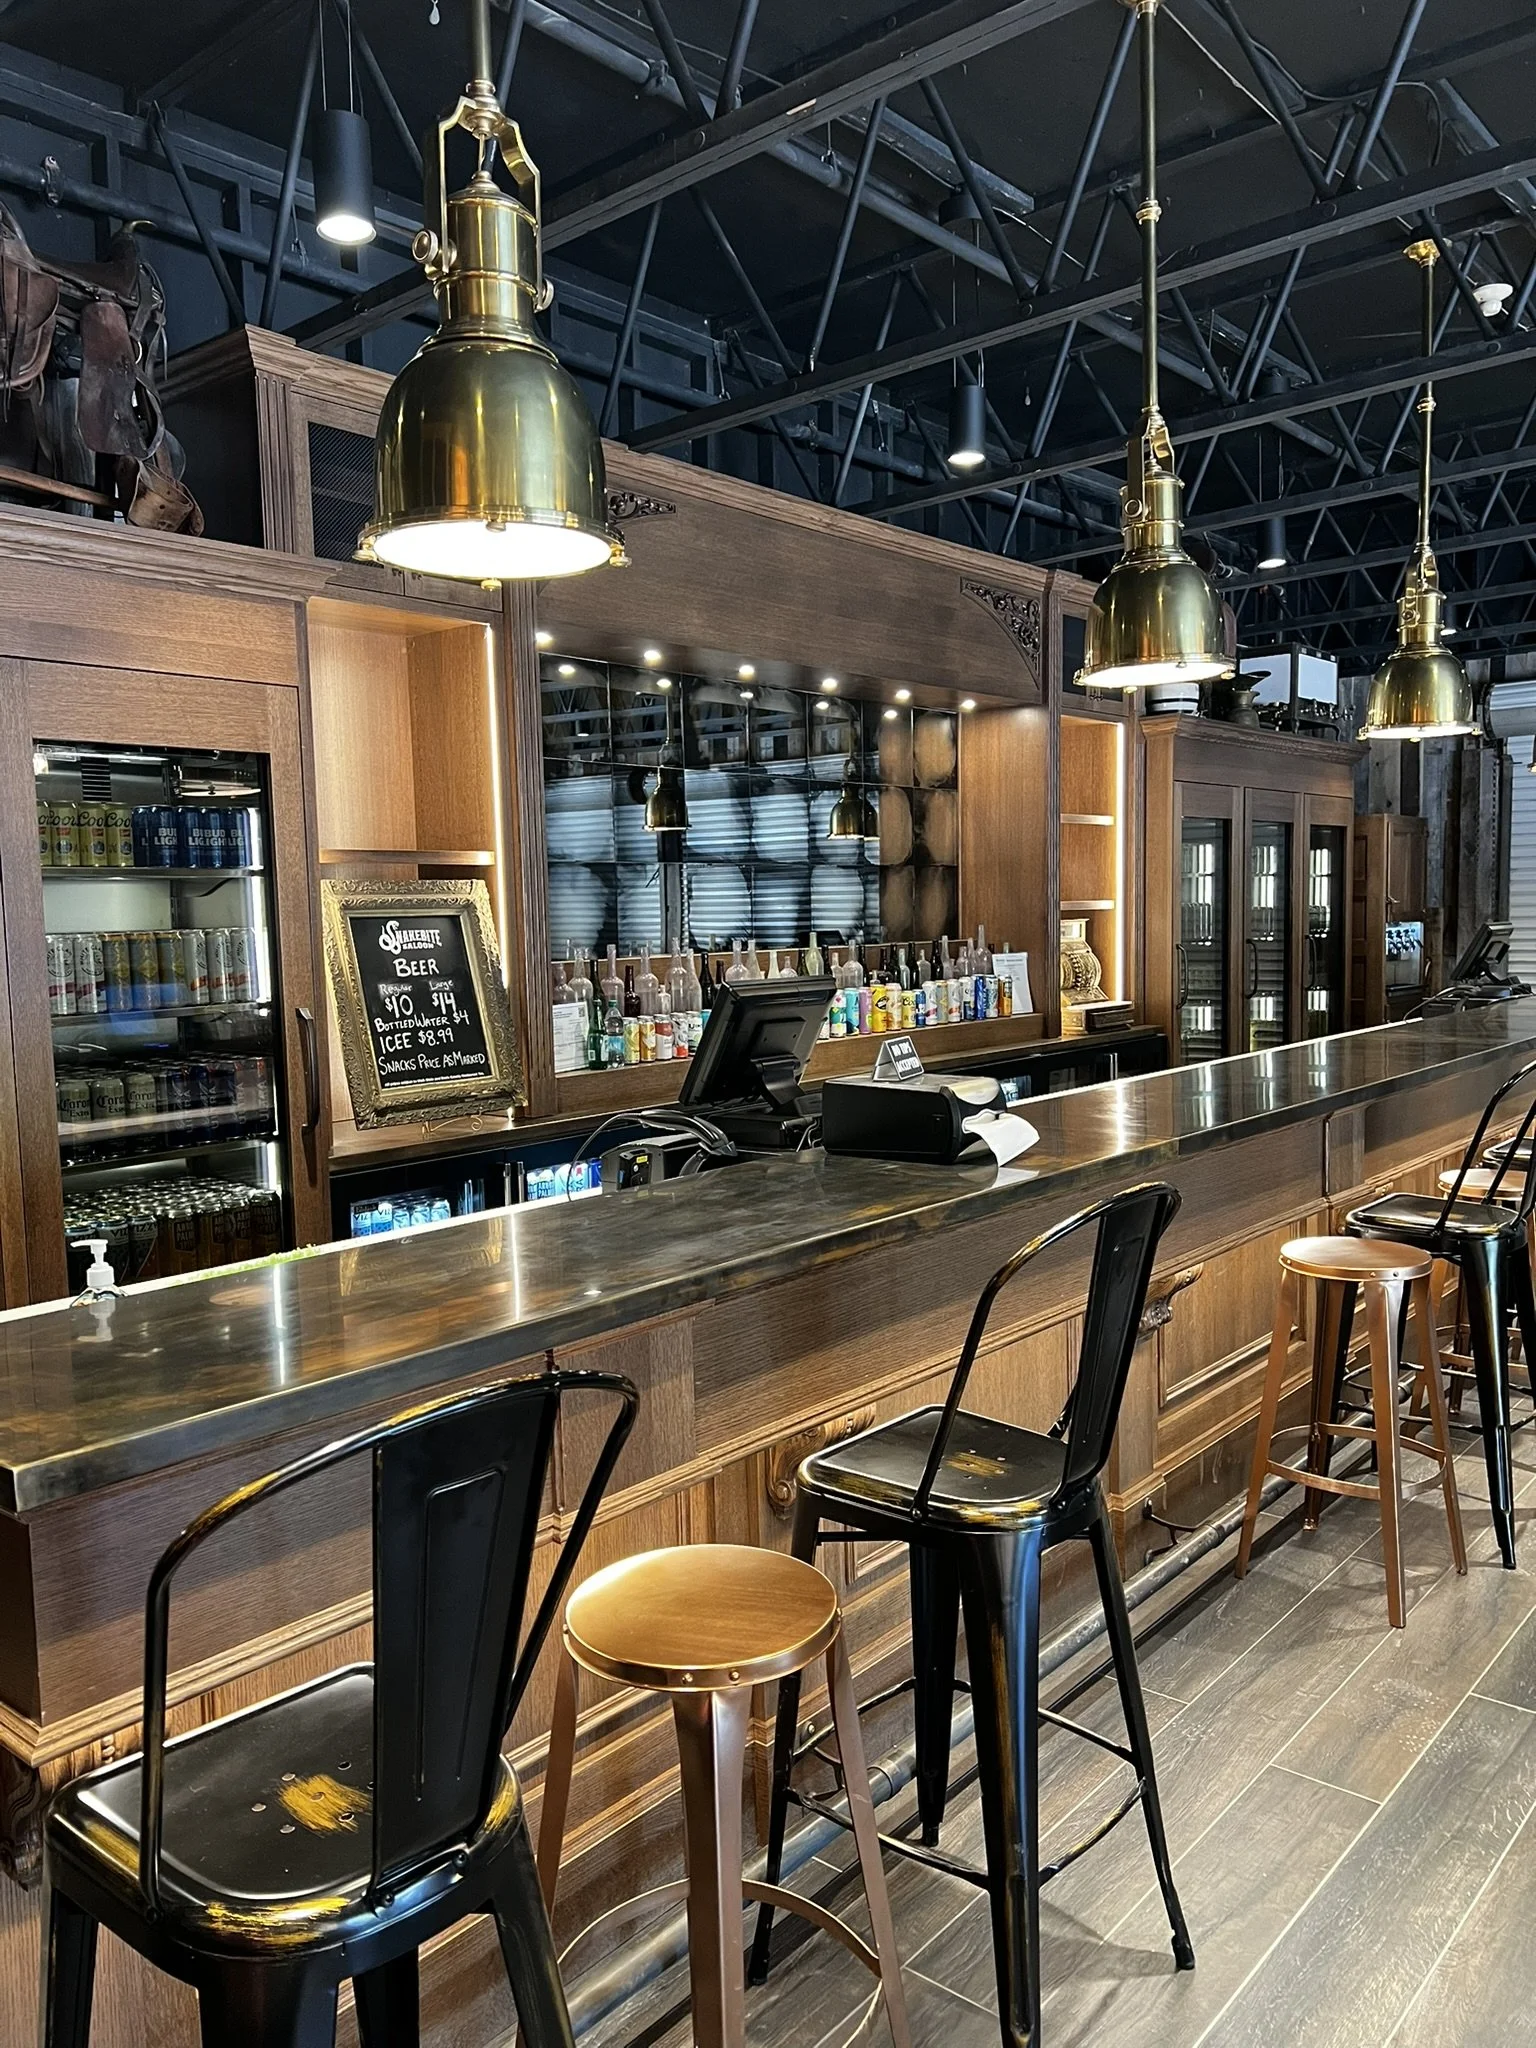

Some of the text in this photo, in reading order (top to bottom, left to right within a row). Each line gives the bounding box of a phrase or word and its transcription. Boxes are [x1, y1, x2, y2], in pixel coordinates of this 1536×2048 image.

[79, 811, 104, 827] Coo
[105, 812, 131, 828] Coo
[158, 828, 177, 837] BU
[228, 837, 244, 846] LIG
[379, 921, 442, 955] SNAKEBITE
[402, 942, 434, 950] SALOON
[393, 958, 440, 977] BEER
[379, 980, 454, 997] Regular Large
[384, 992, 457, 1019] $10 $14
[374, 1009, 470, 1033] BOTTLED WATER $4
[380, 1027, 454, 1055] ICEE $8.99
[378, 1050, 485, 1075] SNACKS PRICE AS MARKED
[60, 1099, 88, 1112] Coro
[97, 1095, 124, 1108] Coro
